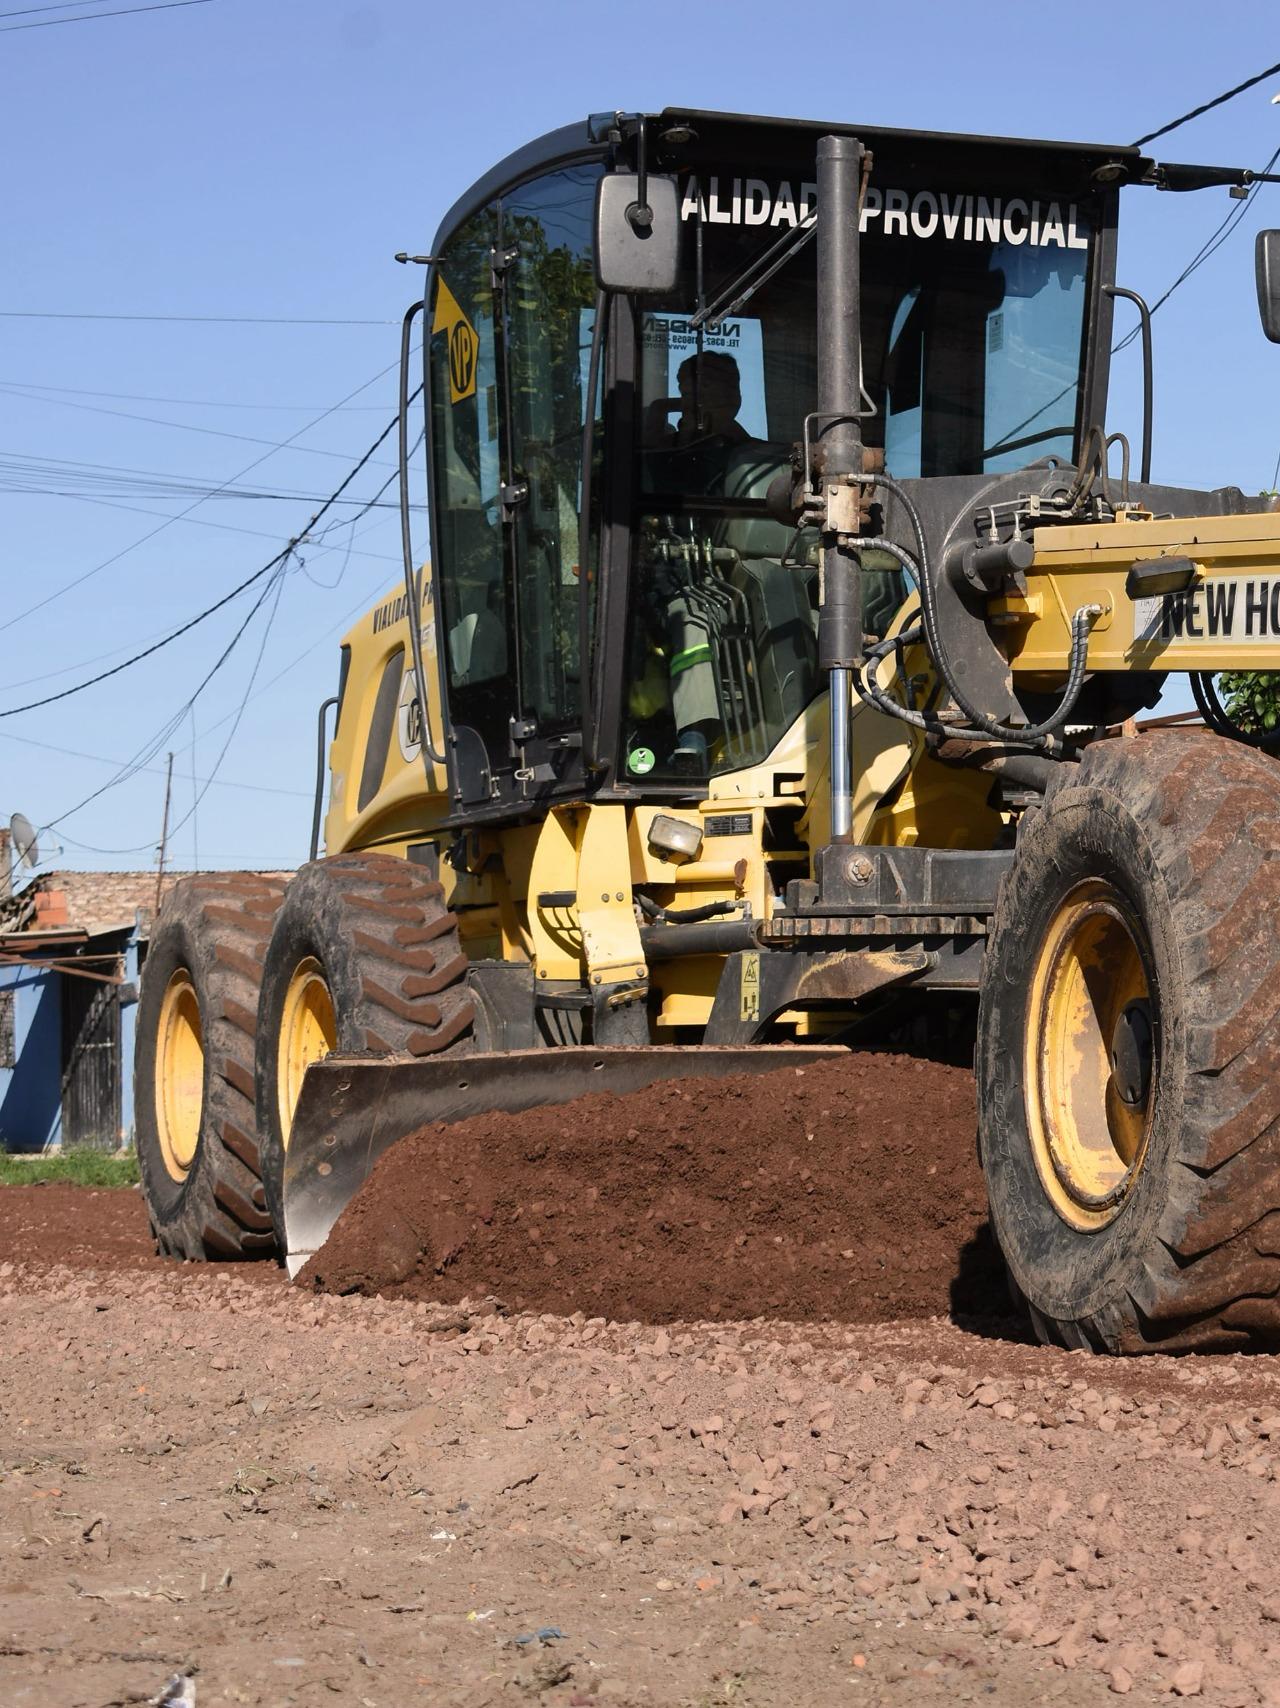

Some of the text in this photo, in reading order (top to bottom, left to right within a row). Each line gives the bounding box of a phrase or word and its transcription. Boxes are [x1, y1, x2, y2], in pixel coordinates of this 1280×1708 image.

[672, 174, 1088, 249] ALIDAD PROVINCIAL
[452, 326, 472, 389] VP
[1162, 582, 1237, 638] NEW
